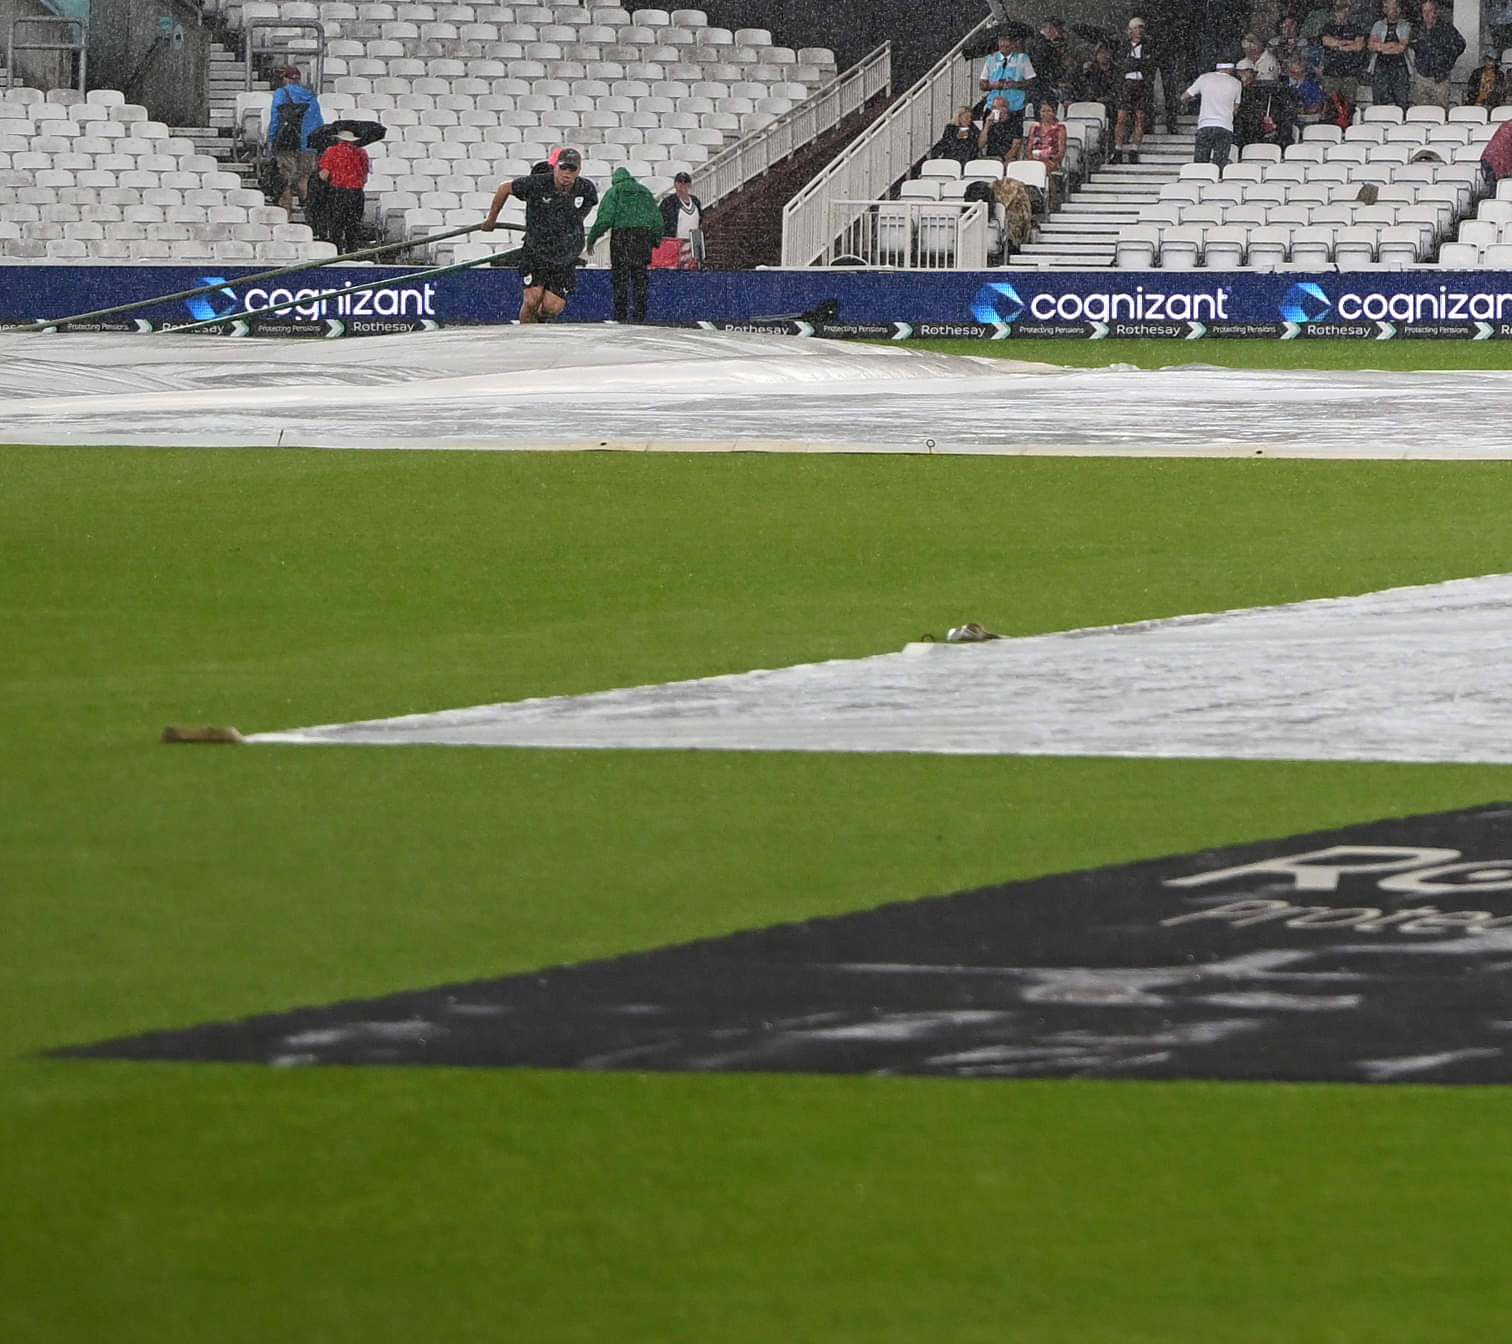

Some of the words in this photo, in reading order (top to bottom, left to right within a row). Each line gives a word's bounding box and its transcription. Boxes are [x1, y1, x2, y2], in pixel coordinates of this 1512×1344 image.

[244, 282, 434, 323] cognizant
[1031, 284, 1229, 323] cognizant
[354, 320, 414, 334] Rothesay
[921, 324, 985, 337] Rothesay
[1117, 324, 1180, 336] Rothesay
[1308, 325, 1371, 337] Rothesay
